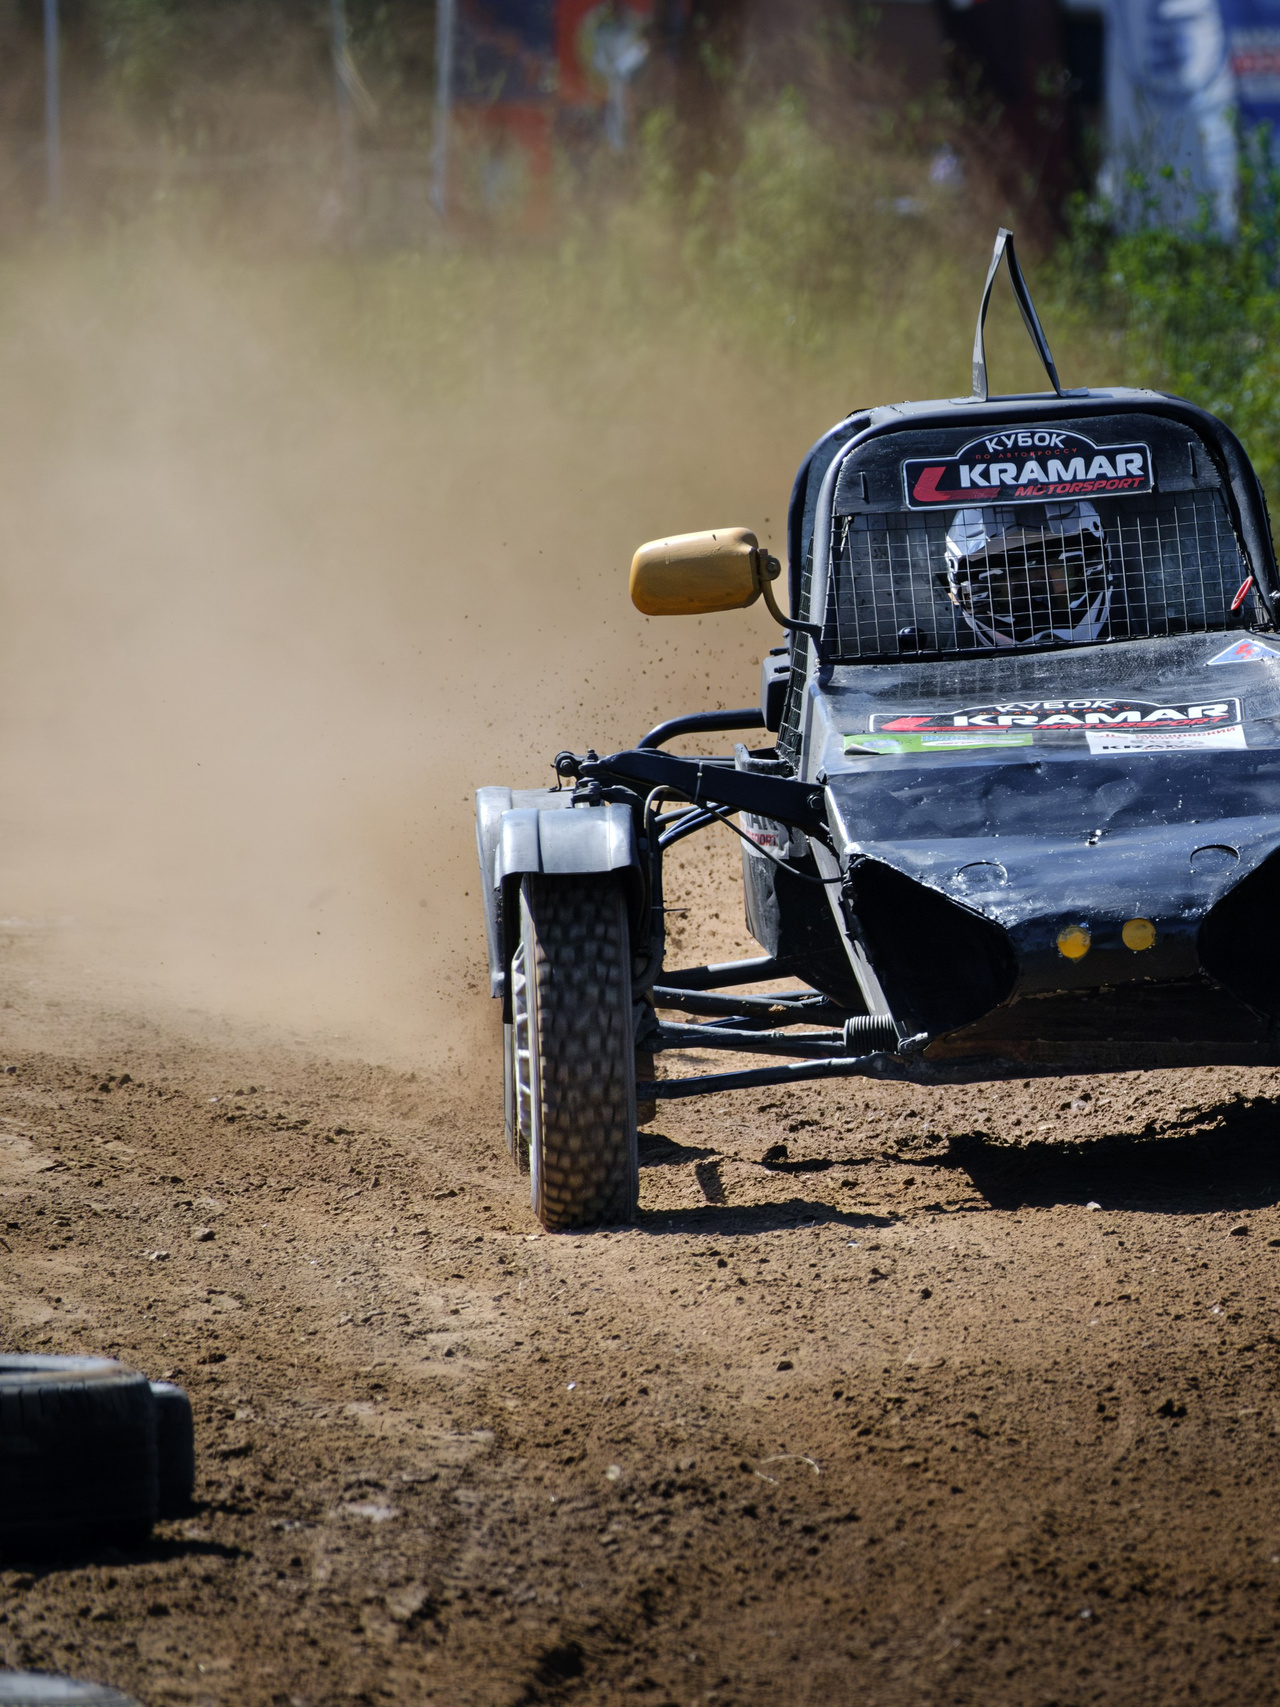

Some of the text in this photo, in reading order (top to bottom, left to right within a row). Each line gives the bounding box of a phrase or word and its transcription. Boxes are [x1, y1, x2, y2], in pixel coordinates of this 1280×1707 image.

[985, 432, 1067, 453] КУБОК
[998, 447, 1078, 459] АВТОКРОССУ
[959, 452, 1145, 488] KRAMAR
[1014, 477, 1145, 497] MOTORSPORT
[953, 704, 1230, 727] KRAMAR
[995, 700, 1117, 713] КУБОК
[1033, 716, 1230, 730] MOTORSPORT
